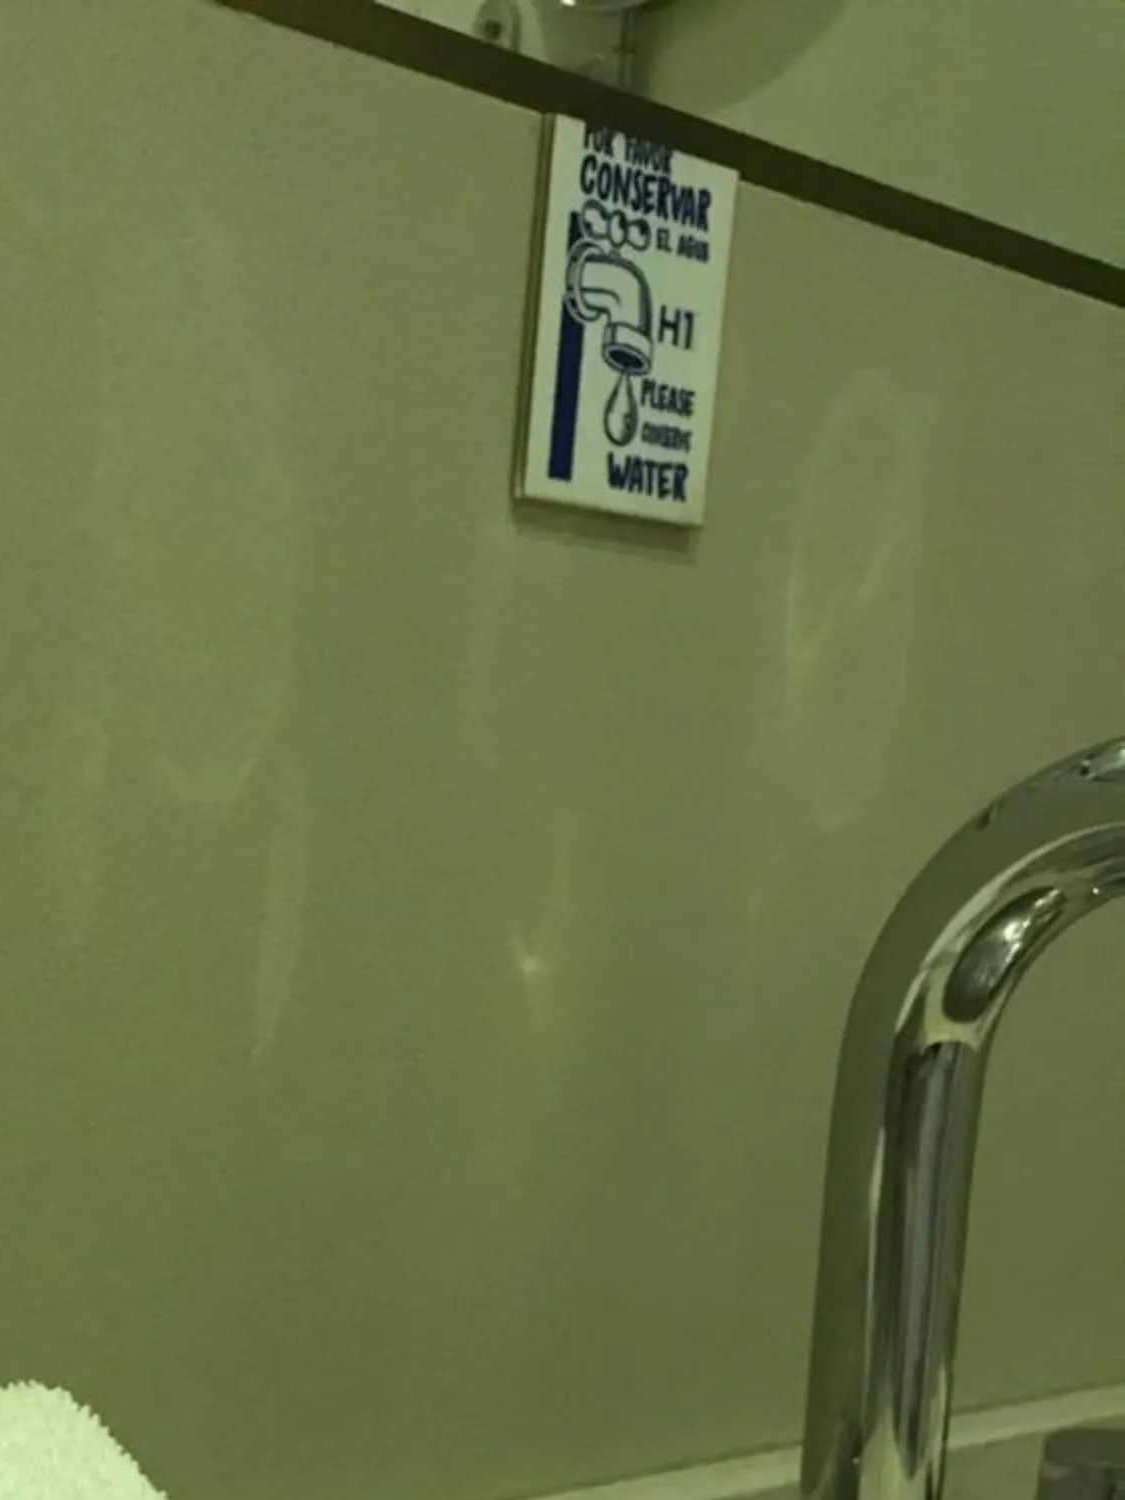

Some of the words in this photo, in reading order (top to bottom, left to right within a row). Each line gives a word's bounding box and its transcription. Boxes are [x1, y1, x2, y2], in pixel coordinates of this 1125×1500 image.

[580, 154, 711, 232] CONSERVAR
[655, 228, 672, 253] EL
[658, 304, 694, 350] H1
[640, 378, 695, 418] PLEASE
[607, 451, 689, 503] WATER
